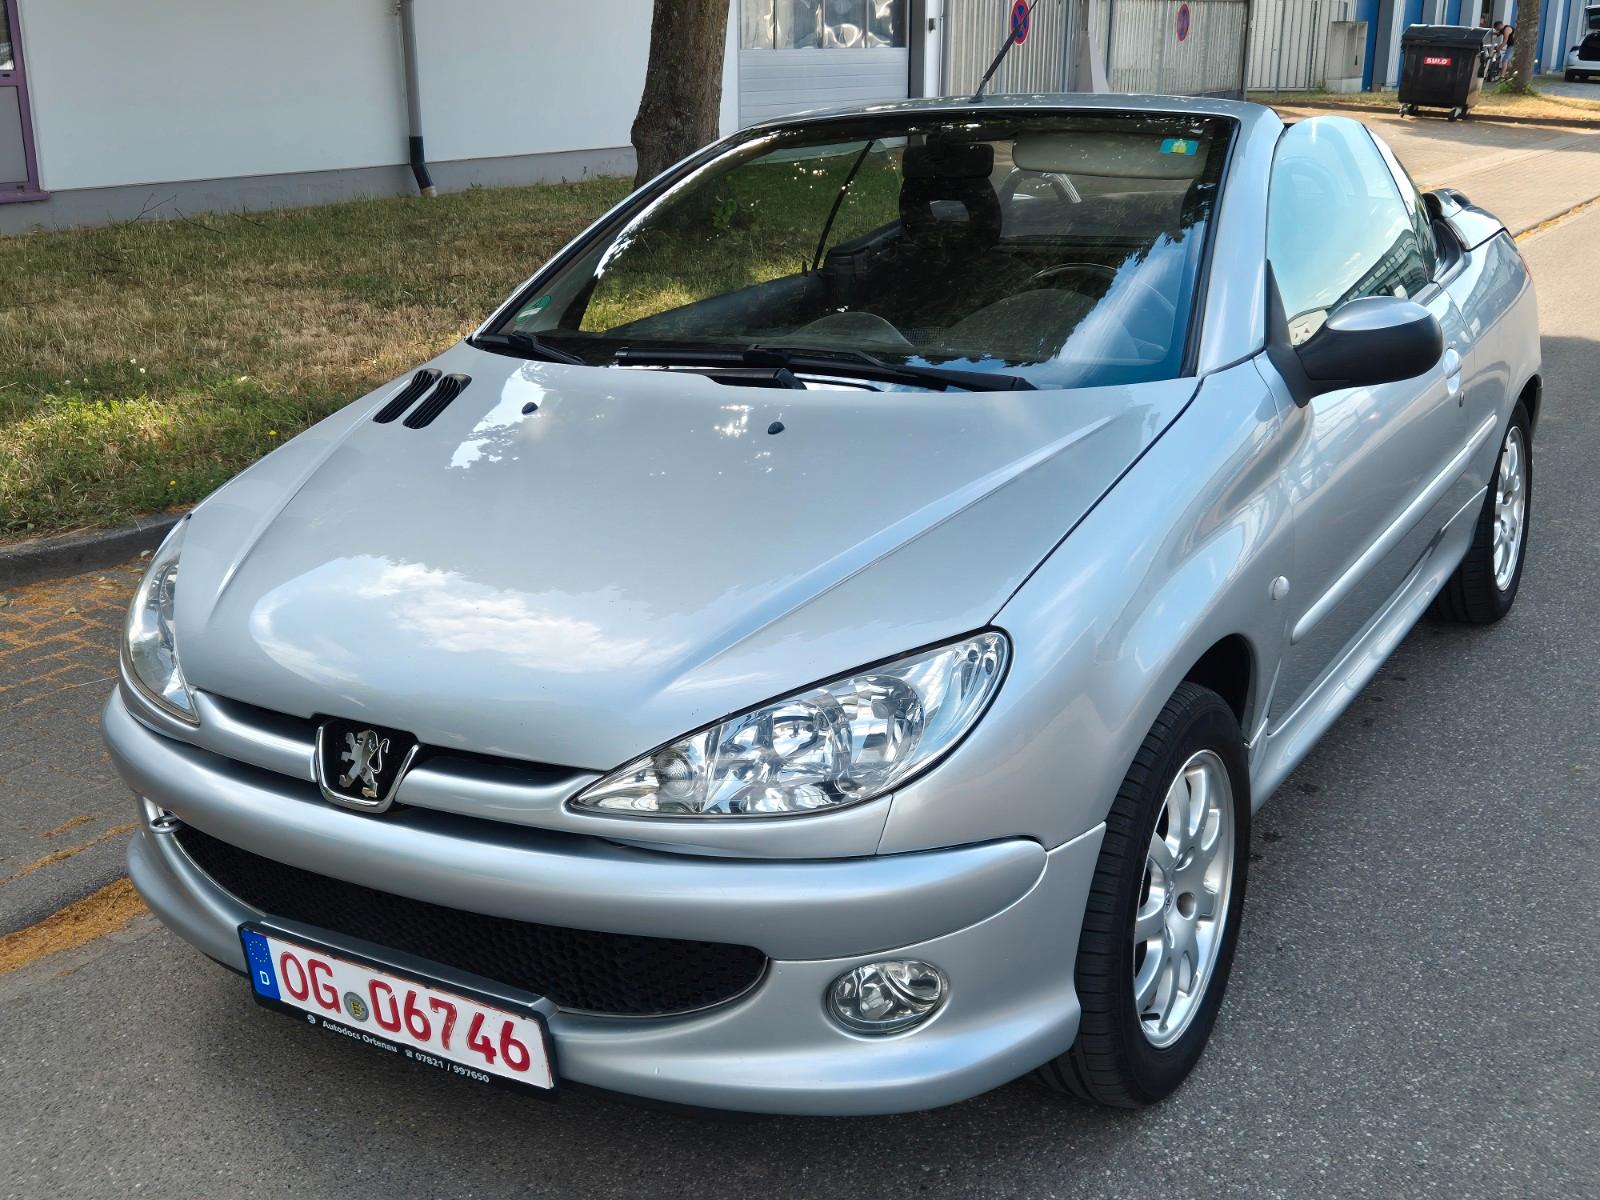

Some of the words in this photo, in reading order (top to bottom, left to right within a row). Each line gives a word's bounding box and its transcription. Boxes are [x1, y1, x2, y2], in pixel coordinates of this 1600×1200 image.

[259, 970, 270, 986] D
[280, 951, 342, 1014] OG
[368, 978, 531, 1072] 06746
[322, 1020, 361, 1040] Autodocs
[362, 1034, 398, 1053] Ortenau
[415, 1052, 444, 1069] 07821
[452, 1065, 490, 1083] 997650
